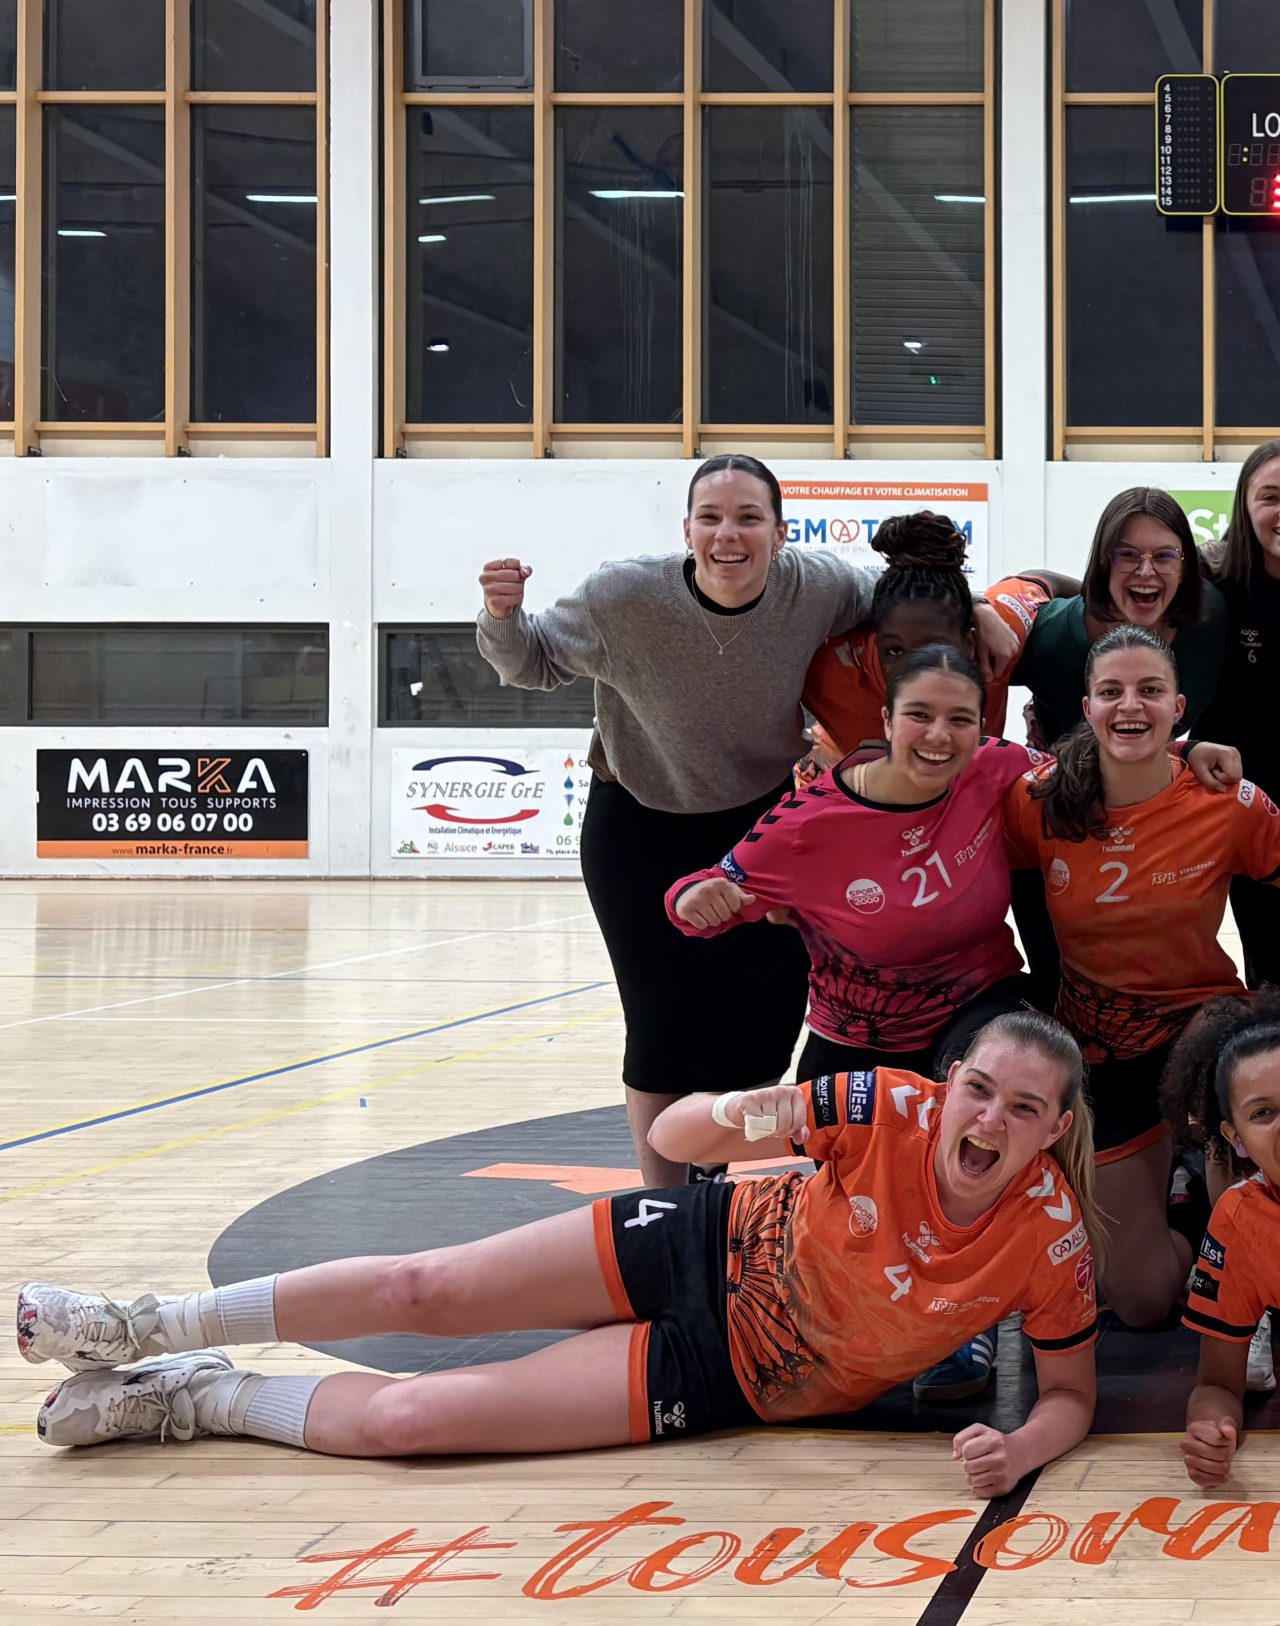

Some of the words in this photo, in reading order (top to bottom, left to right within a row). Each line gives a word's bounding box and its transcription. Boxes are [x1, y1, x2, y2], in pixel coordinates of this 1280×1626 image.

[1164, 83, 1172, 92] 4
[1164, 93, 1172, 102] 5
[1164, 103, 1172, 112] 6
[1164, 114, 1172, 123] 7
[1164, 124, 1172, 133] 8
[1164, 134, 1172, 143] 9
[1160, 145, 1172, 154] 10
[1160, 155, 1172, 164] 11
[1160, 165, 1172, 175] 12
[1160, 175, 1172, 185] 13
[1160, 186, 1172, 195] 14
[1160, 196, 1172, 205] 15
[783, 487, 810, 496] VOTRE
[812, 487, 863, 496] CHAUFFAGE
[864, 487, 873, 496] ET
[875, 488, 902, 496] VOTRE
[904, 488, 968, 497] CLIMATISATION
[1247, 649, 1257, 663] 6
[67, 757, 276, 794] MARKA
[406, 781, 507, 799] SYNERGIE
[511, 781, 545, 799] GrE
[67, 797, 150, 809] IMPRESSION
[161, 797, 197, 809] TOUS
[207, 797, 277, 809] SUPPORTS
[92, 813, 120, 832] 03
[124, 813, 151, 832] 69
[157, 813, 186, 832] 06
[191, 813, 218, 832] 07
[223, 813, 253, 832] 00
[429, 826, 457, 834] Installation
[458, 826, 484, 836] Climatique
[485, 826, 491, 834] et
[444, 842, 478, 852] Alsace
[901, 850, 953, 908] 21
[1095, 861, 1130, 903] 2
[849, 885, 879, 898] SPORT
[854, 896, 880, 907] 2000
[624, 1198, 678, 1229] 4
[902, 1231, 933, 1264] hummel
[883, 1263, 913, 1302] 4
[652, 1400, 665, 1435] hummel
